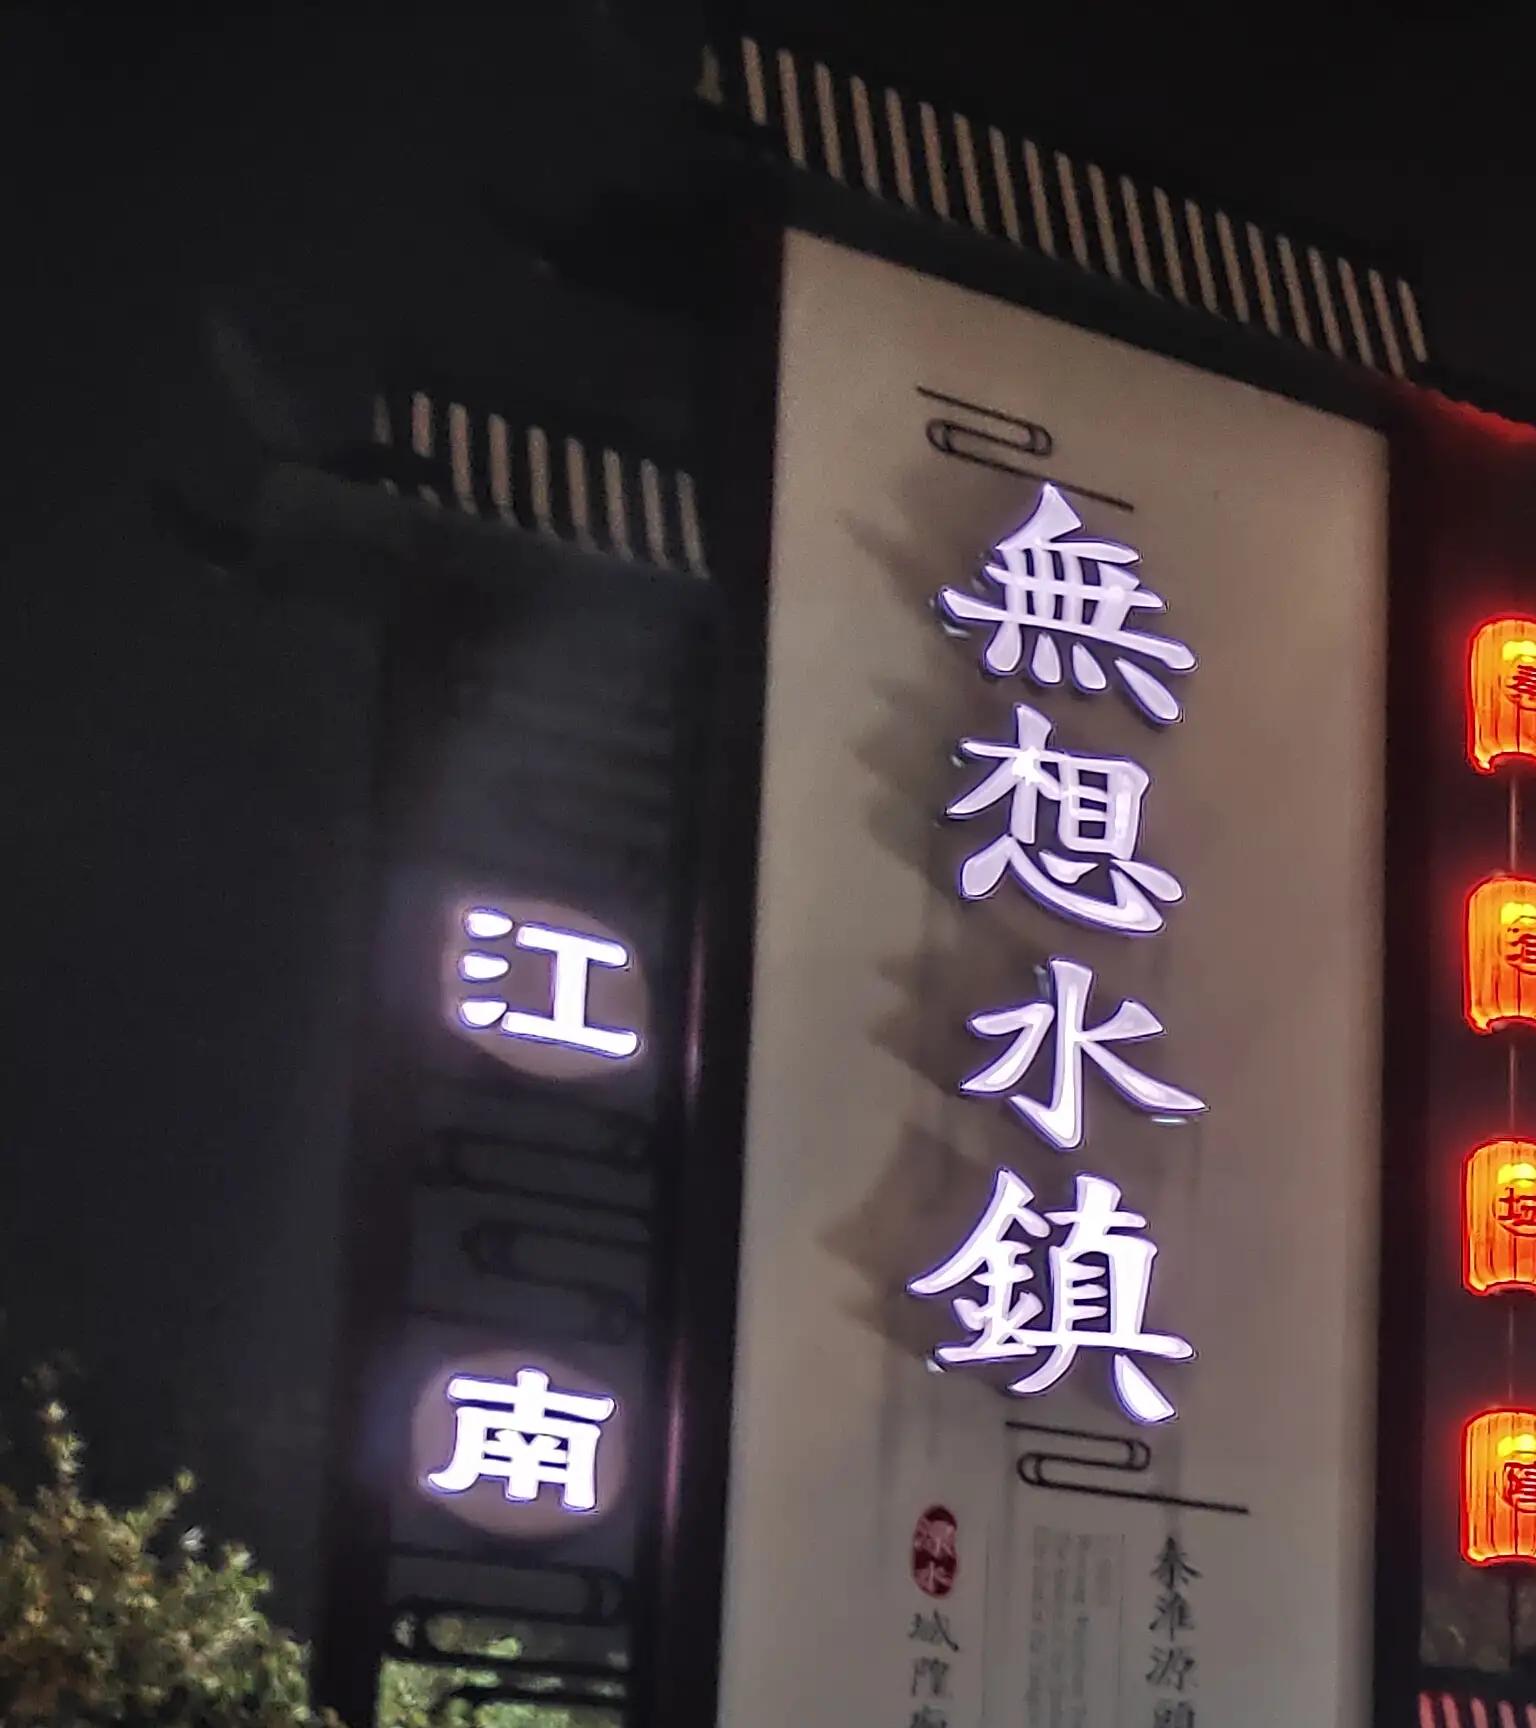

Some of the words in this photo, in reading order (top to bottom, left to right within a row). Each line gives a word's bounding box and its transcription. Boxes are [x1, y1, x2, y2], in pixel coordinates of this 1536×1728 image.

[423, 905, 641, 1511] 江南
[904, 481, 1208, 1422] 無想水鎮
